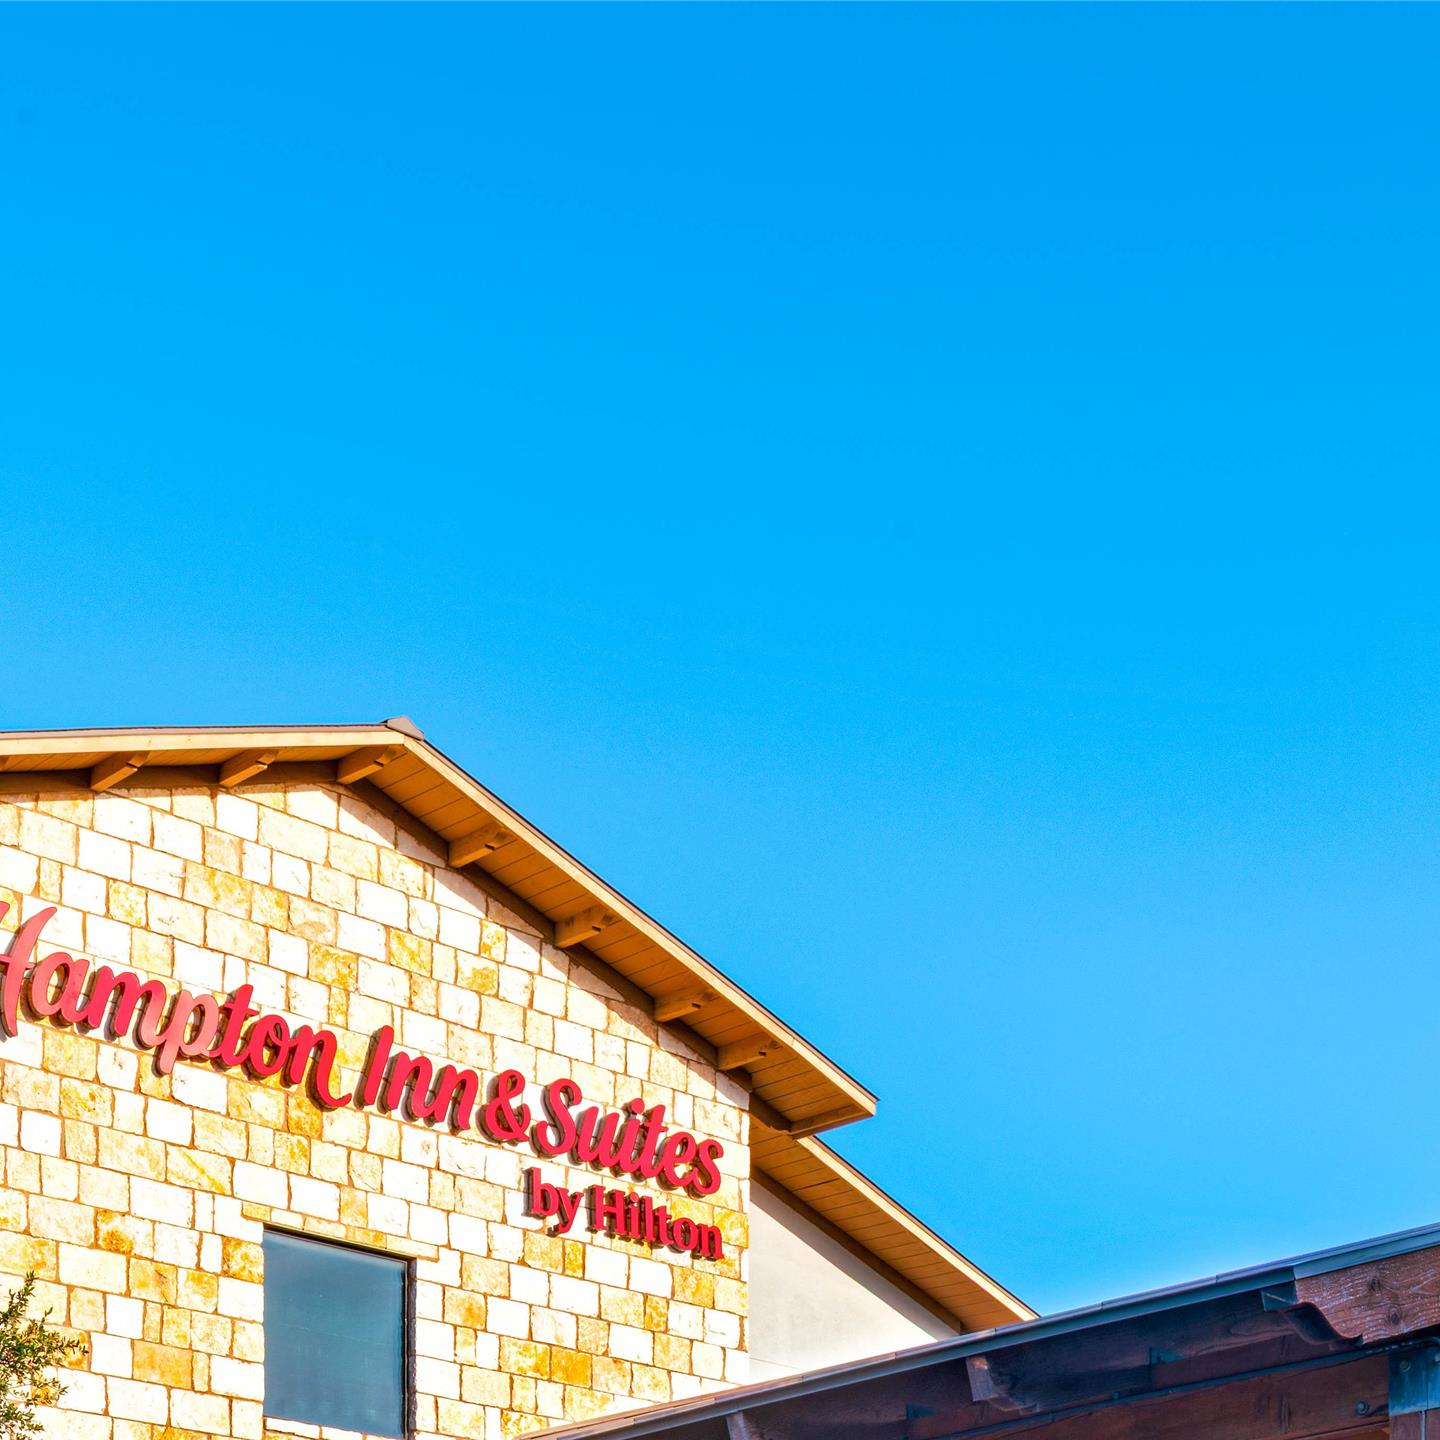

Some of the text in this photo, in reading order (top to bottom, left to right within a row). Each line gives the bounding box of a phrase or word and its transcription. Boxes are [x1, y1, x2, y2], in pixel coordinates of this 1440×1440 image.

[357, 1024, 479, 1133] Inn
[481, 1068, 532, 1143] &
[533, 1077, 724, 1197] Suites
[527, 1166, 724, 1261] by Hilton
